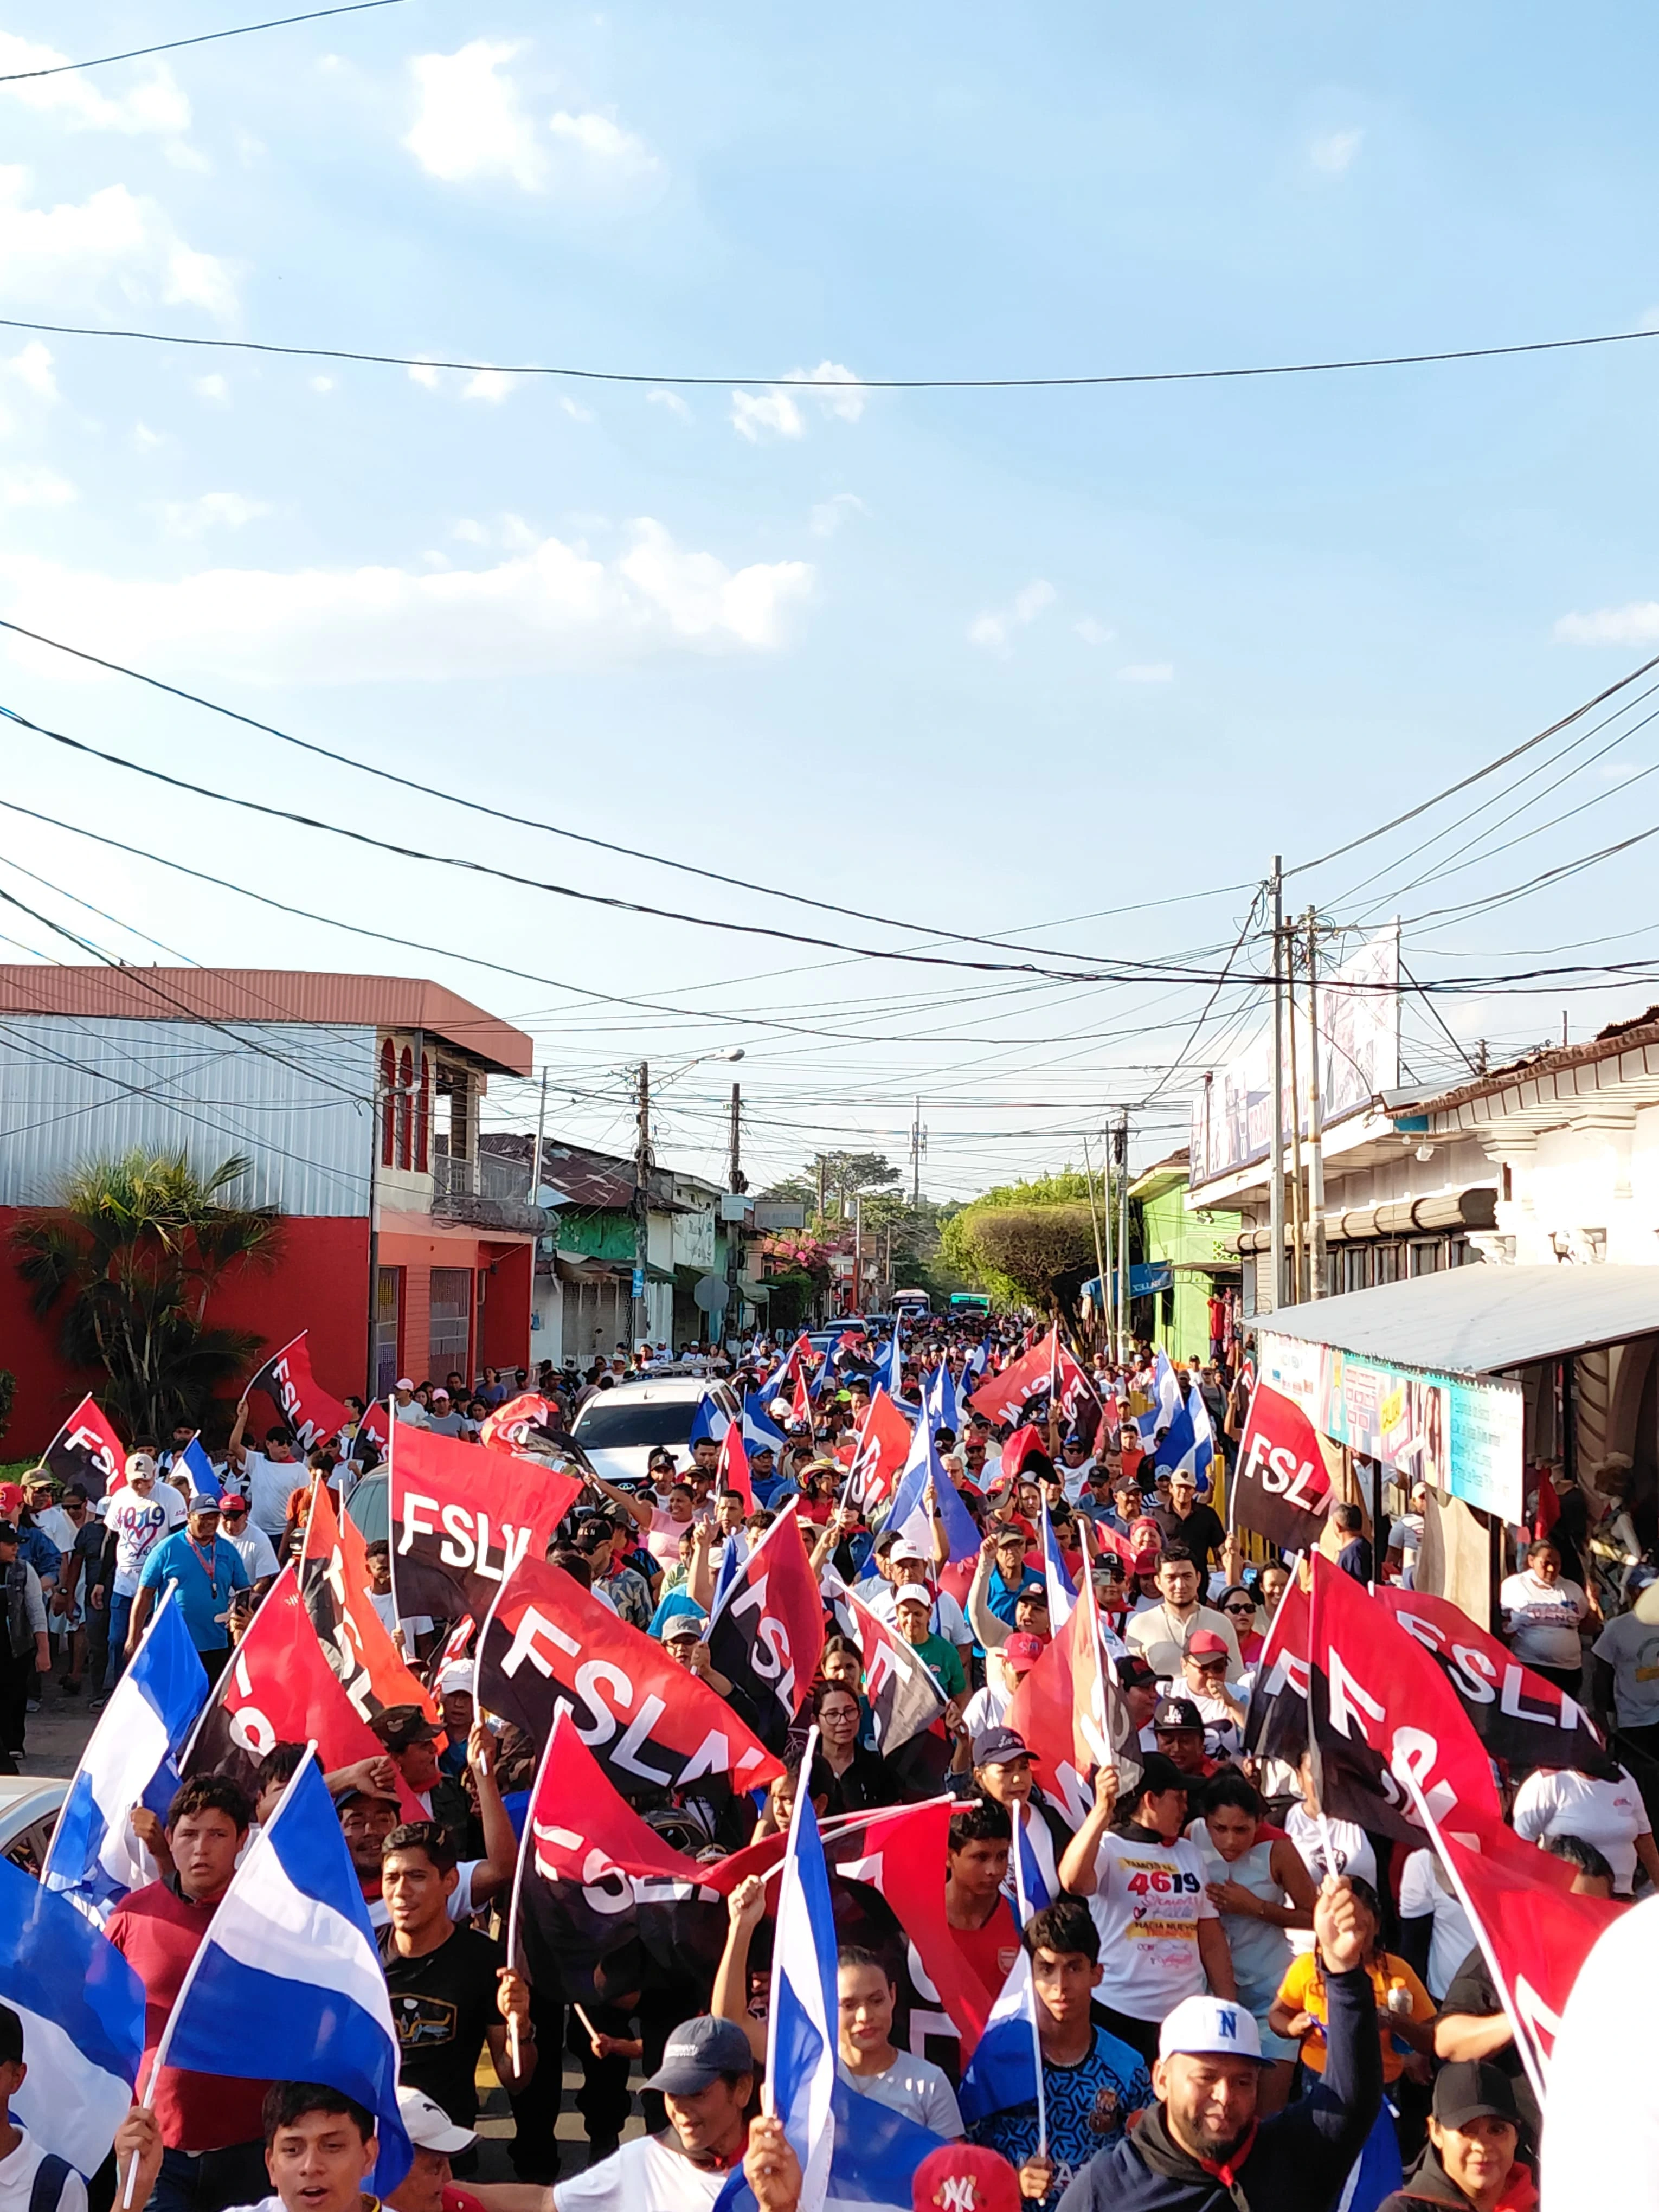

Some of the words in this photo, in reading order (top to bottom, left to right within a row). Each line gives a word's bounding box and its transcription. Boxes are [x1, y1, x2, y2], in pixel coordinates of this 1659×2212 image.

[1128, 1871, 1201, 1896] 4619
[1216, 2009, 1237, 2040] N
[942, 2175, 975, 2212] NY
